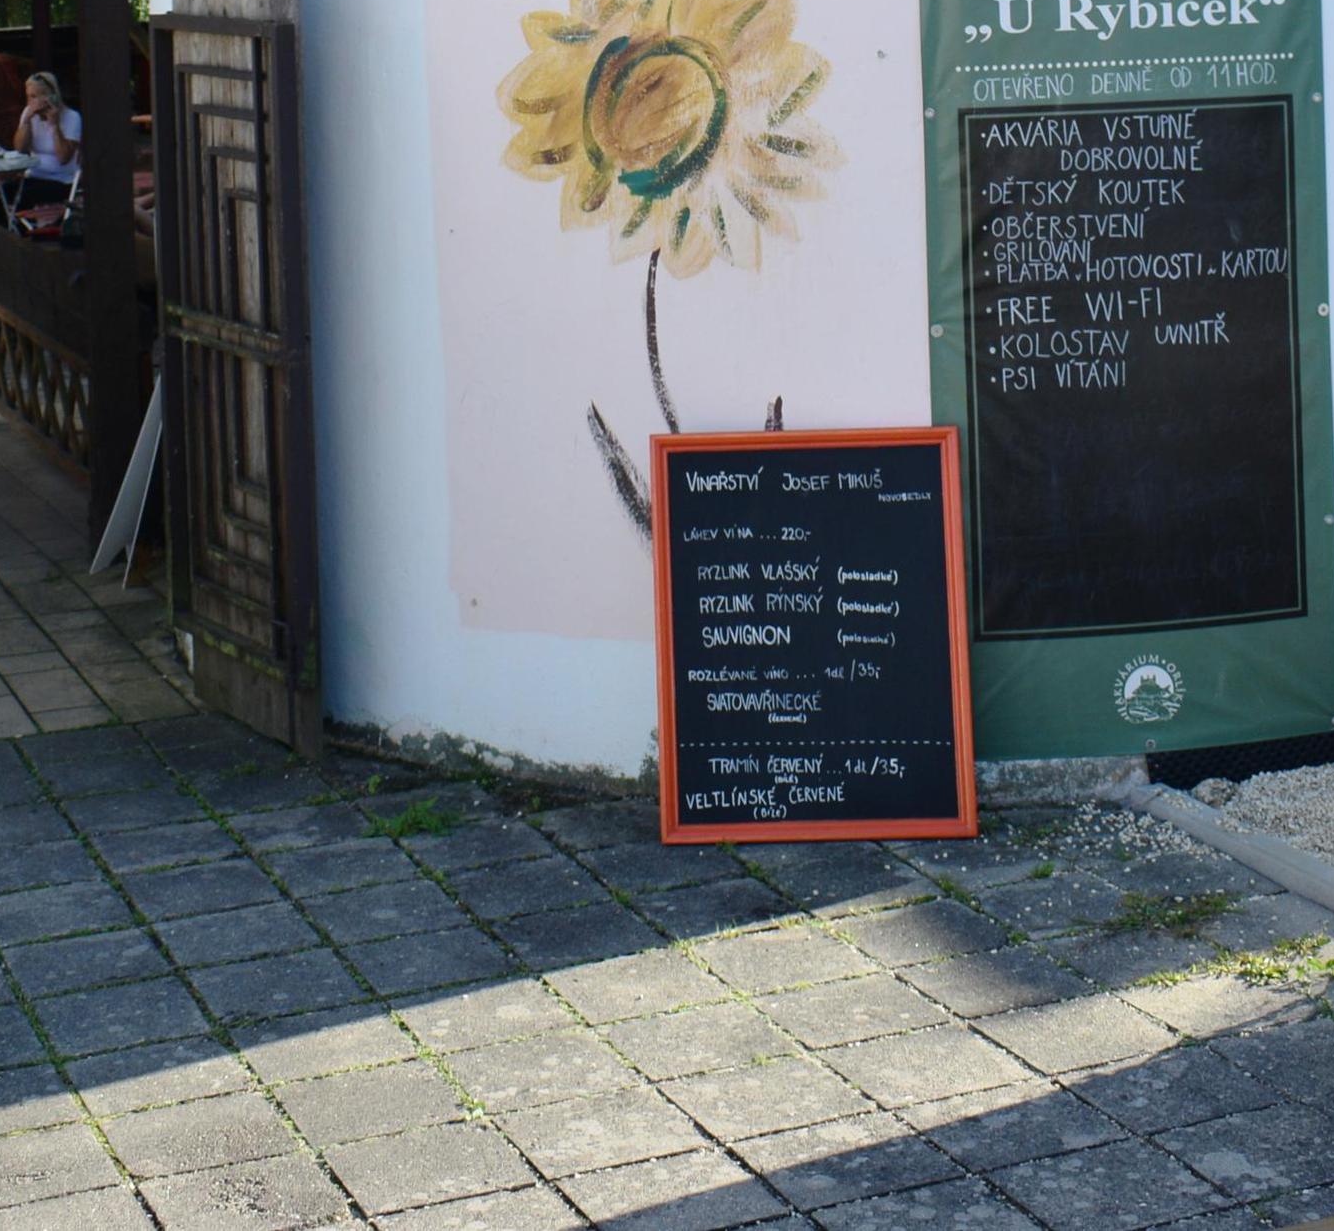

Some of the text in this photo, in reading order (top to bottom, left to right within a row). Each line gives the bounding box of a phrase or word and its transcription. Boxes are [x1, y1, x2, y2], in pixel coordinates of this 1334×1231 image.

[973, 72, 1074, 102] OTEVŘENO
[1091, 66, 1153, 95] DENNĚ
[1170, 66, 1192, 88] OD
[985, 108, 1198, 148] AKVÁRIA VSTUPNÉ
[1060, 140, 1204, 172] DOBROVOLNÉ
[988, 174, 1186, 206] DĚTSKÝ KOUTEK
[991, 206, 1152, 240] OBČERSTVENÍ
[993, 236, 1095, 264] GRILOVÁNÍ
[997, 263, 1069, 284] PLATBA
[1086, 253, 1202, 282] HOTOVOSTI
[1221, 247, 1288, 278] KARTOU
[997, 286, 1163, 327] FREE WI-FI
[1001, 312, 1230, 359] KOLOSTAV UVNITŘ
[1002, 366, 1037, 393] PSI
[838, 468, 884, 491] MIKUŠ
[697, 563, 751, 581] RYZLINK
[699, 594, 755, 614] RYZLINK
[766, 586, 824, 615] RÝNSKÝ
[702, 624, 791, 648] SAUVIGNON
[688, 665, 758, 682] ROZLÉVANÉ
[1114, 654, 1159, 705] AKVÁRIUM
[767, 753, 824, 774] ČERVENÝ
[685, 781, 846, 810] VELTLÍNSKÉ ČERVENÉ
